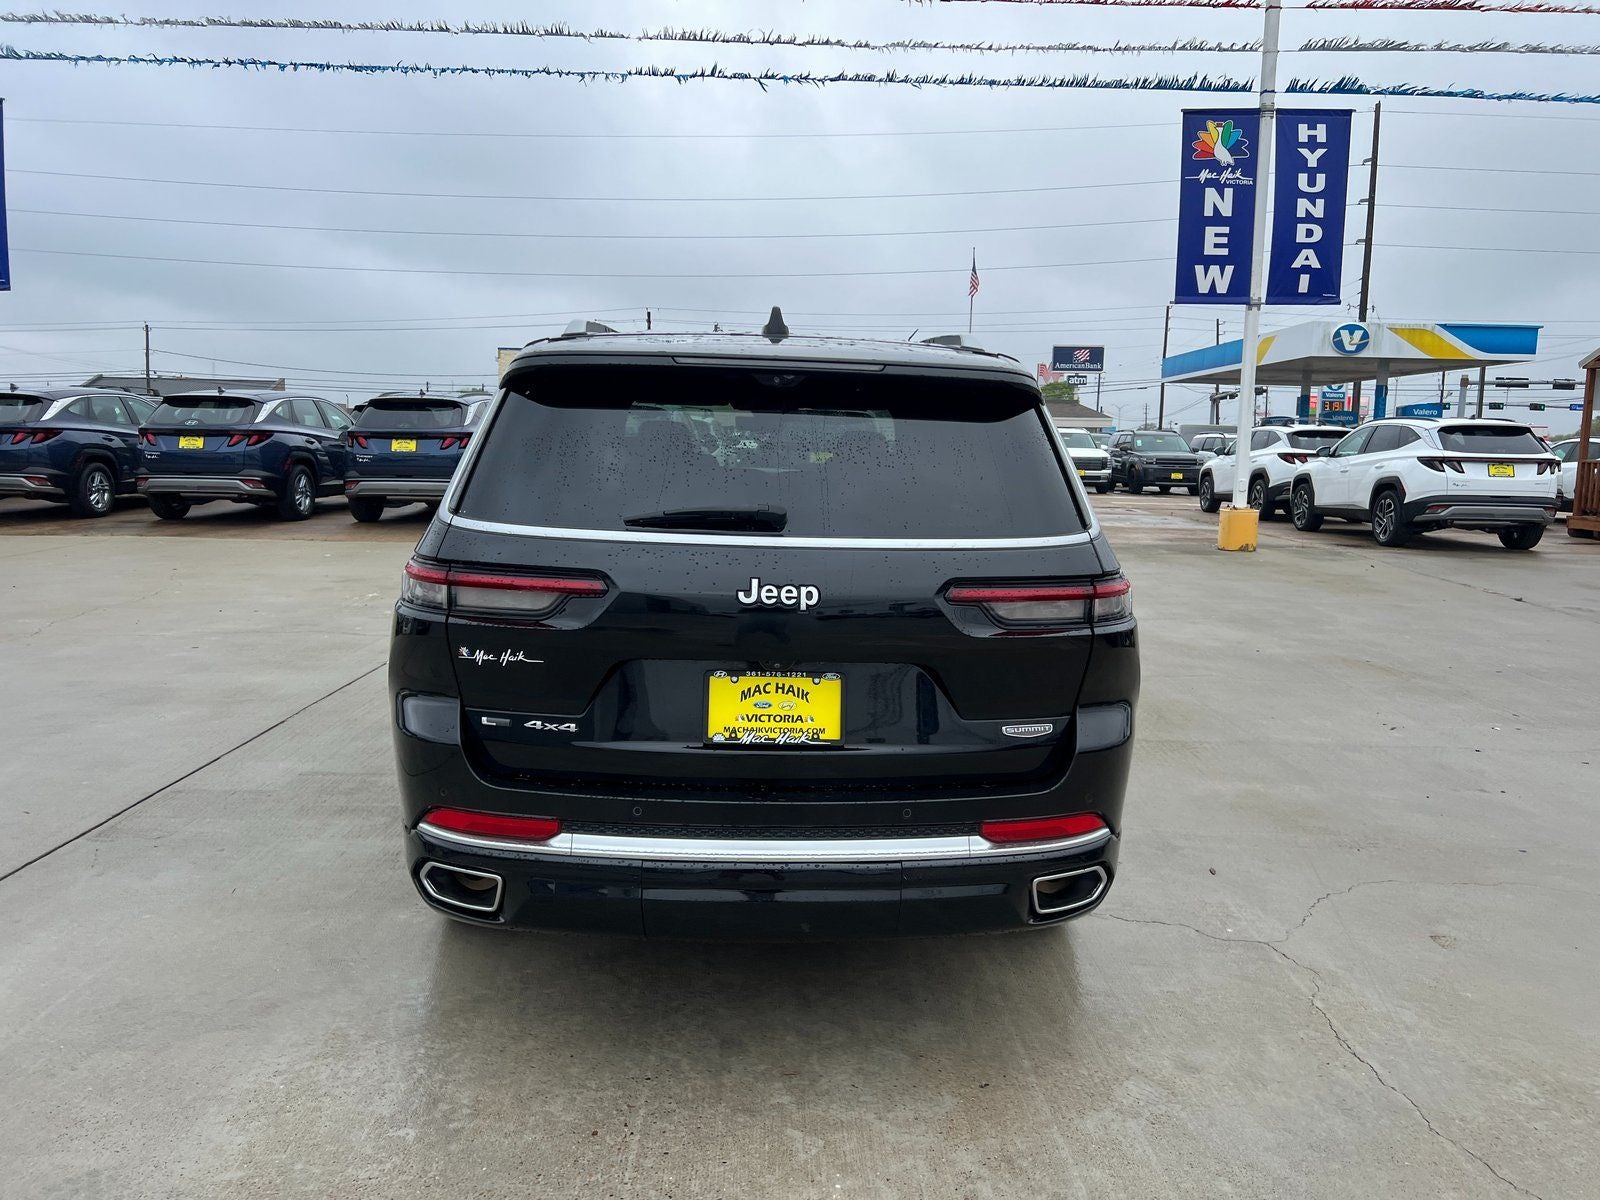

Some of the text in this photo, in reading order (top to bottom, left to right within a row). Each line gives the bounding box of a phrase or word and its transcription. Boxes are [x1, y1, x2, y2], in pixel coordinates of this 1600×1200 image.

[1190, 167, 1253, 184] Mac Haik
[1291, 123, 1327, 293] HYUNDAI
[1194, 187, 1234, 294] NEW
[1068, 376, 1086, 384] atm
[1413, 408, 1438, 416] Valero
[738, 578, 819, 611] Jeep
[466, 649, 544, 666] Mac Haik
[740, 682, 810, 703] MAC HAIK
[523, 720, 578, 733] 4x4
[745, 714, 804, 723] VICTORIA
[774, 731, 831, 745] Haik
